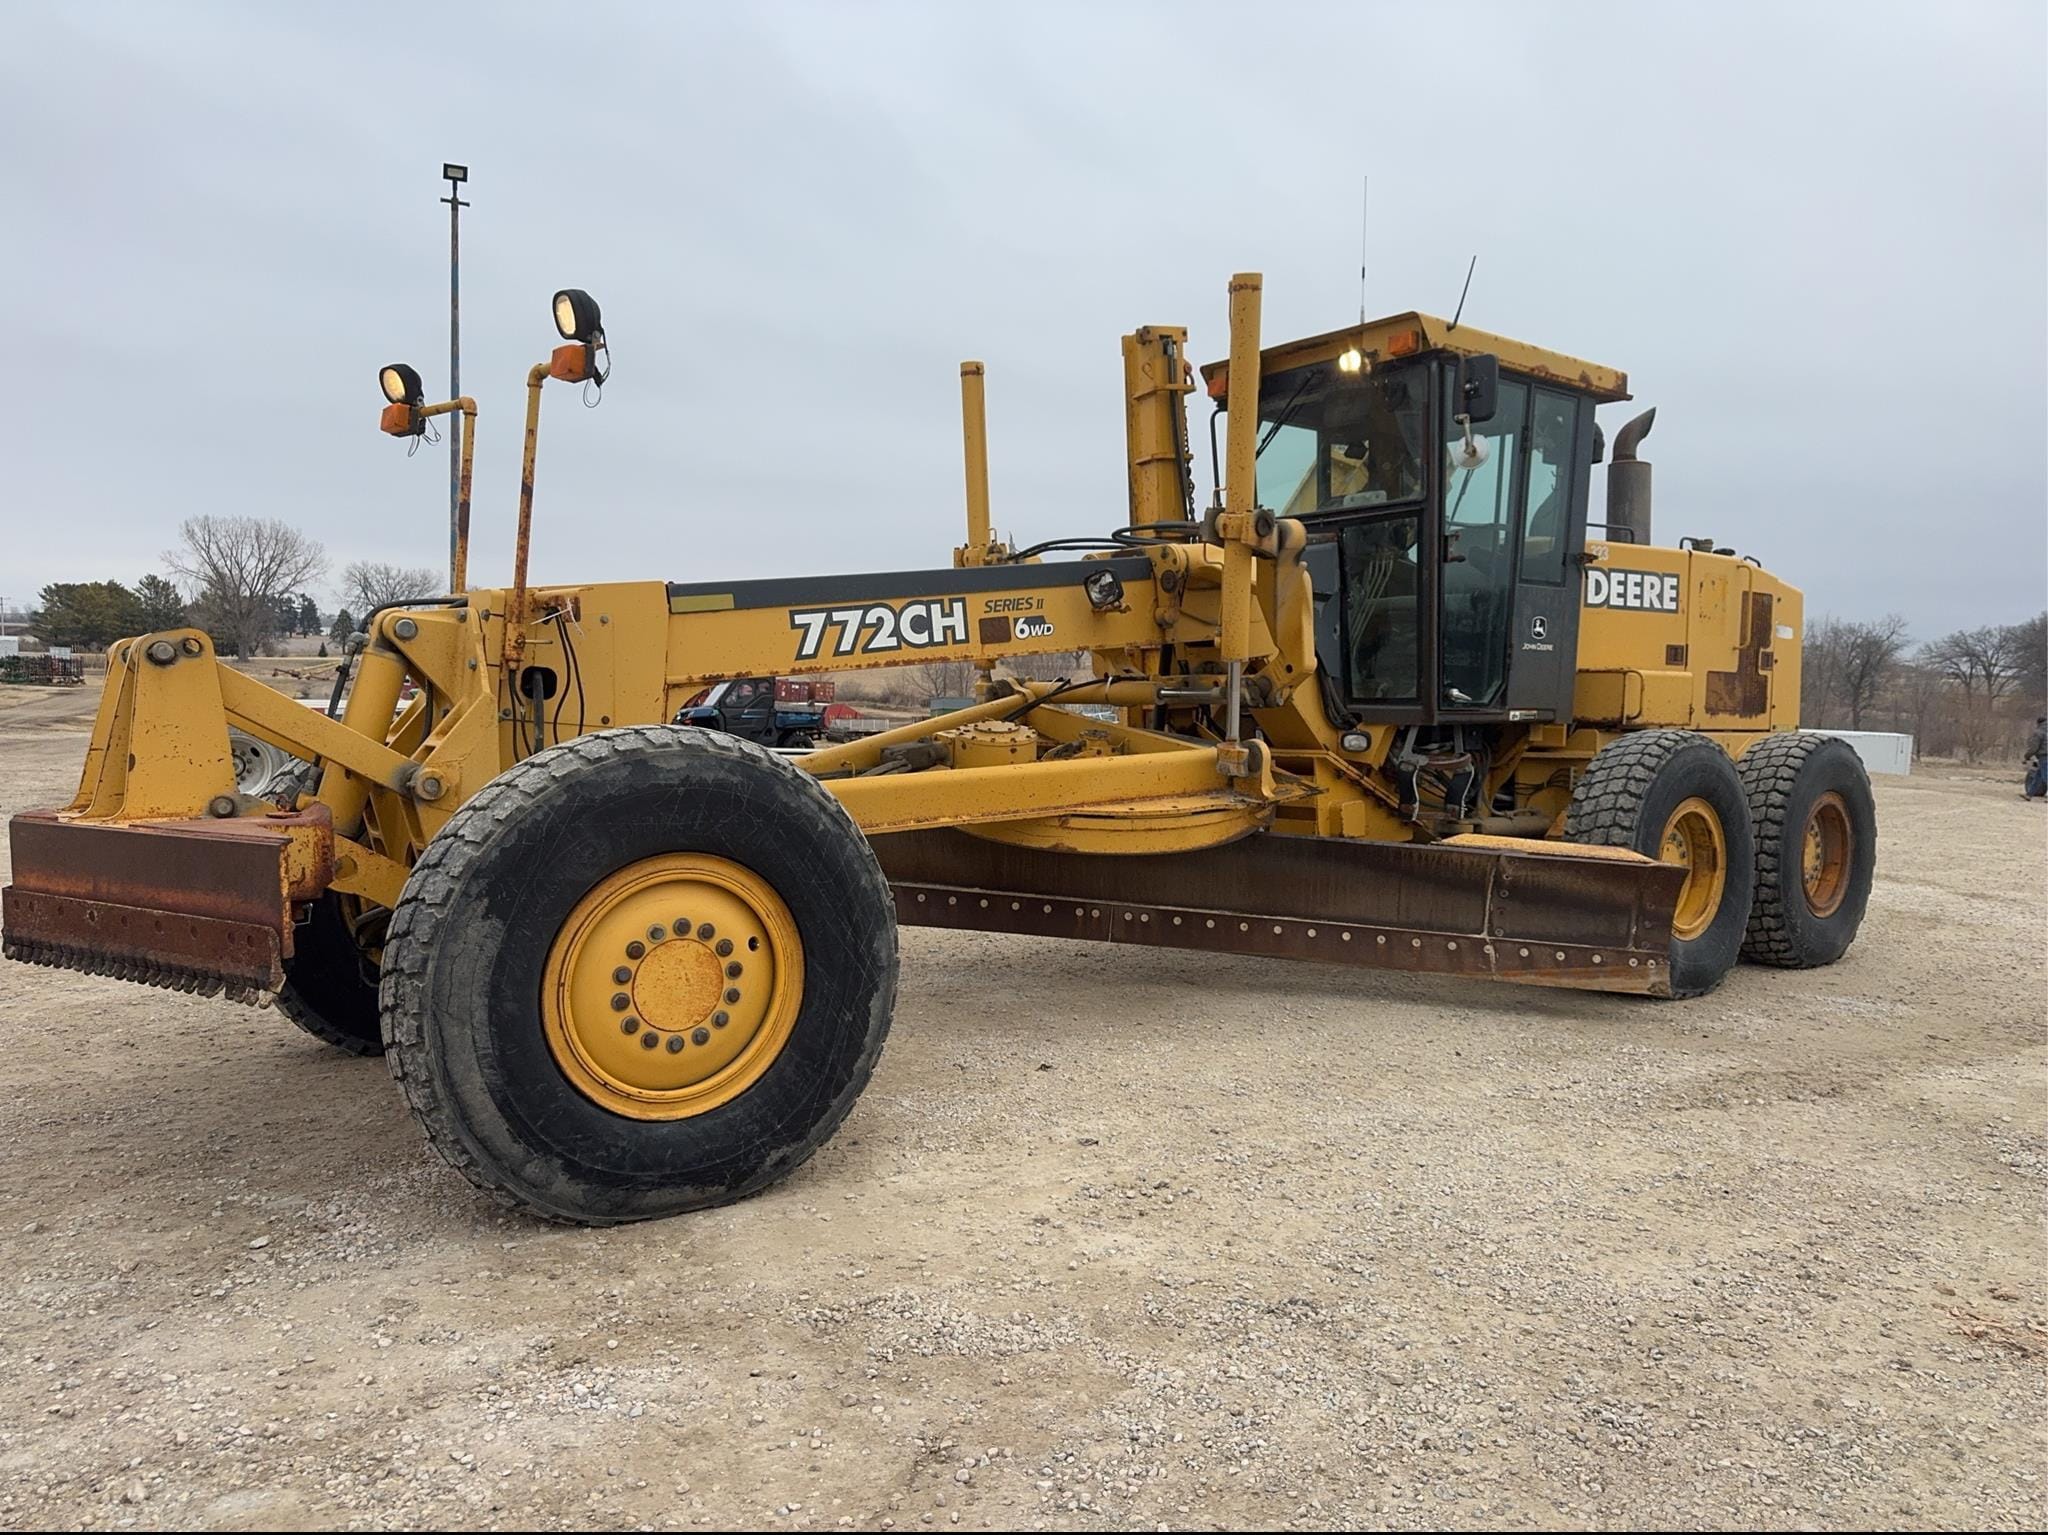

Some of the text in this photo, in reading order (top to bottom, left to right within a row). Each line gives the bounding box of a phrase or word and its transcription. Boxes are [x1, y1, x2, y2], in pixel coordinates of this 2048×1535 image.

[984, 597, 1044, 613] SERIES II
[1586, 569, 1678, 611] DEERE
[791, 599, 968, 658] 772CH
[1014, 617, 1053, 639] 6WD
